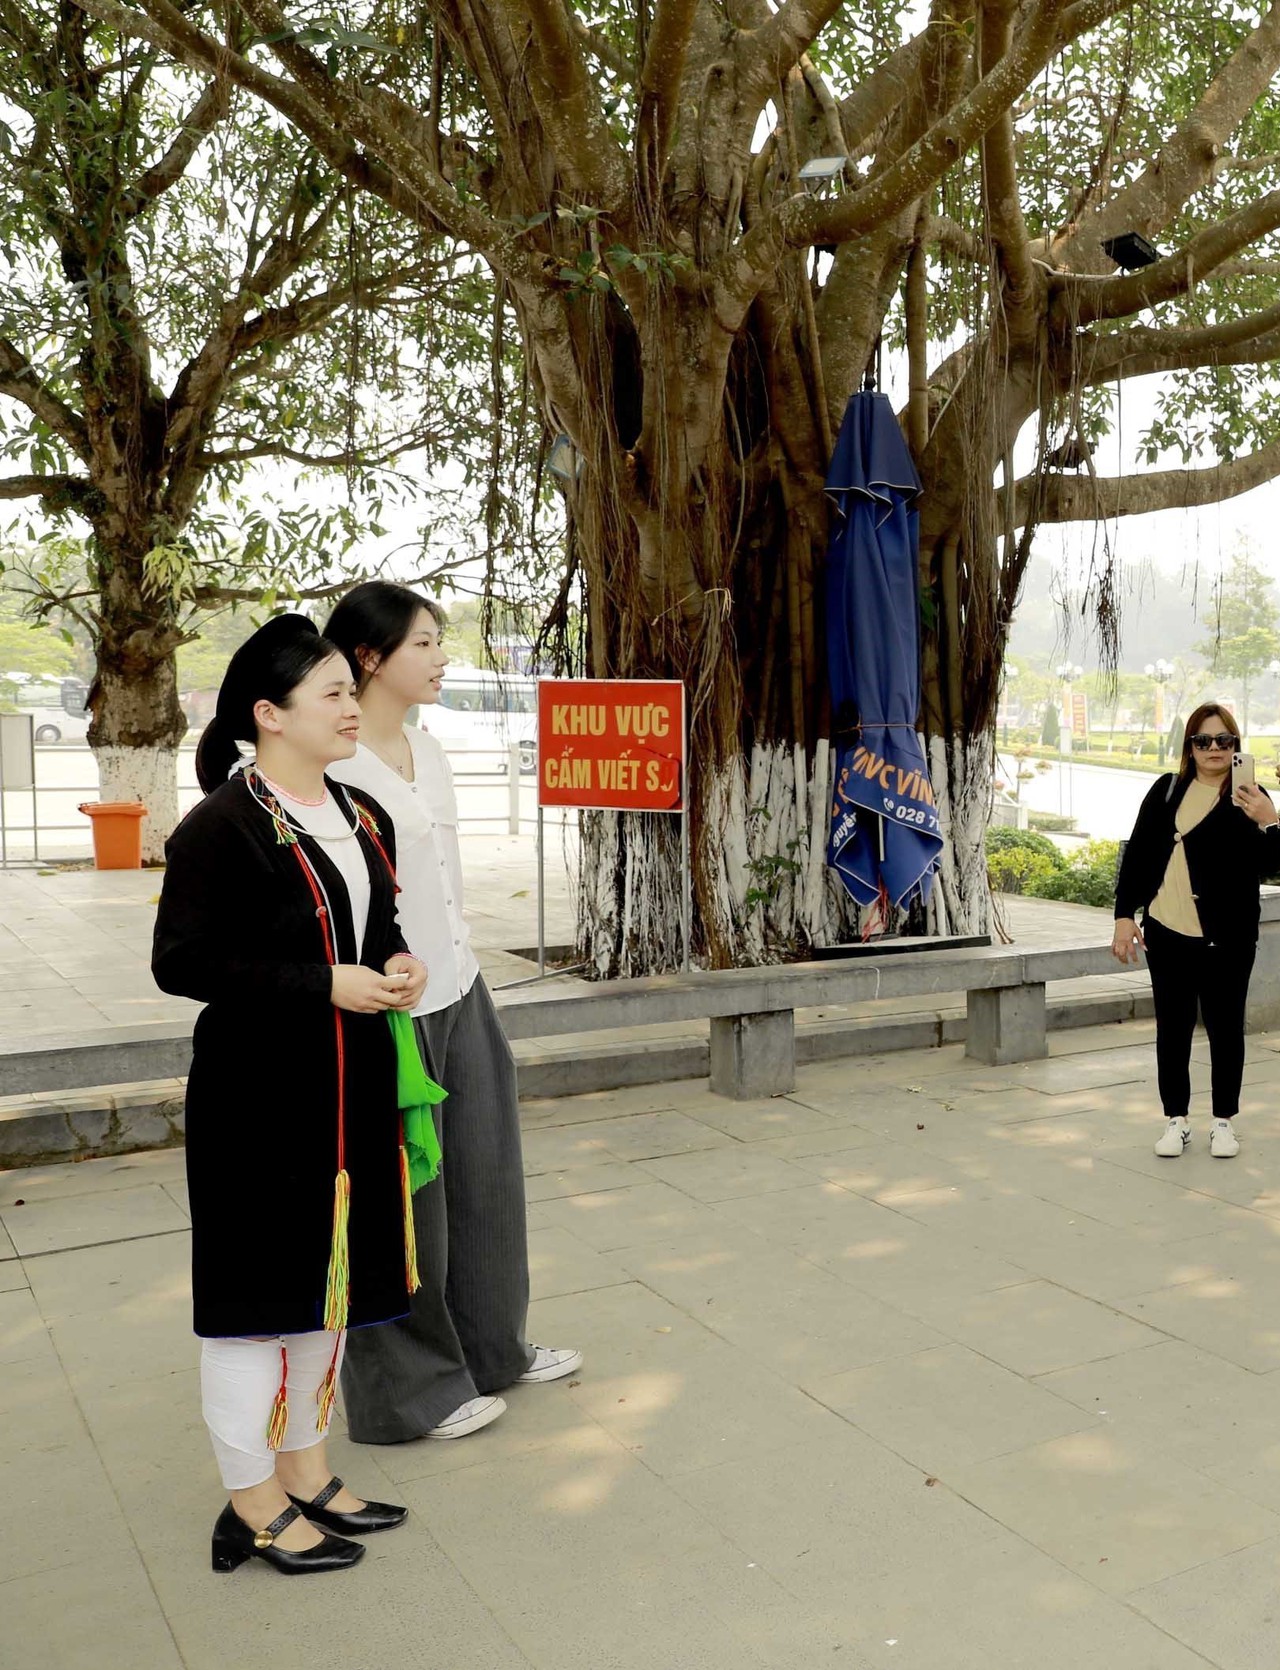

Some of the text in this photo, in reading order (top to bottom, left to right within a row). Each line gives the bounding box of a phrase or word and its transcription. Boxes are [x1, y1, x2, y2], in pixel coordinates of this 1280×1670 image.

[552, 702, 669, 744] KHU VỰC
[545, 746, 592, 789] CẤM
[597, 749, 641, 790] VIẾT
[897, 768, 937, 810] VĨN
[895, 805, 926, 825] 028
